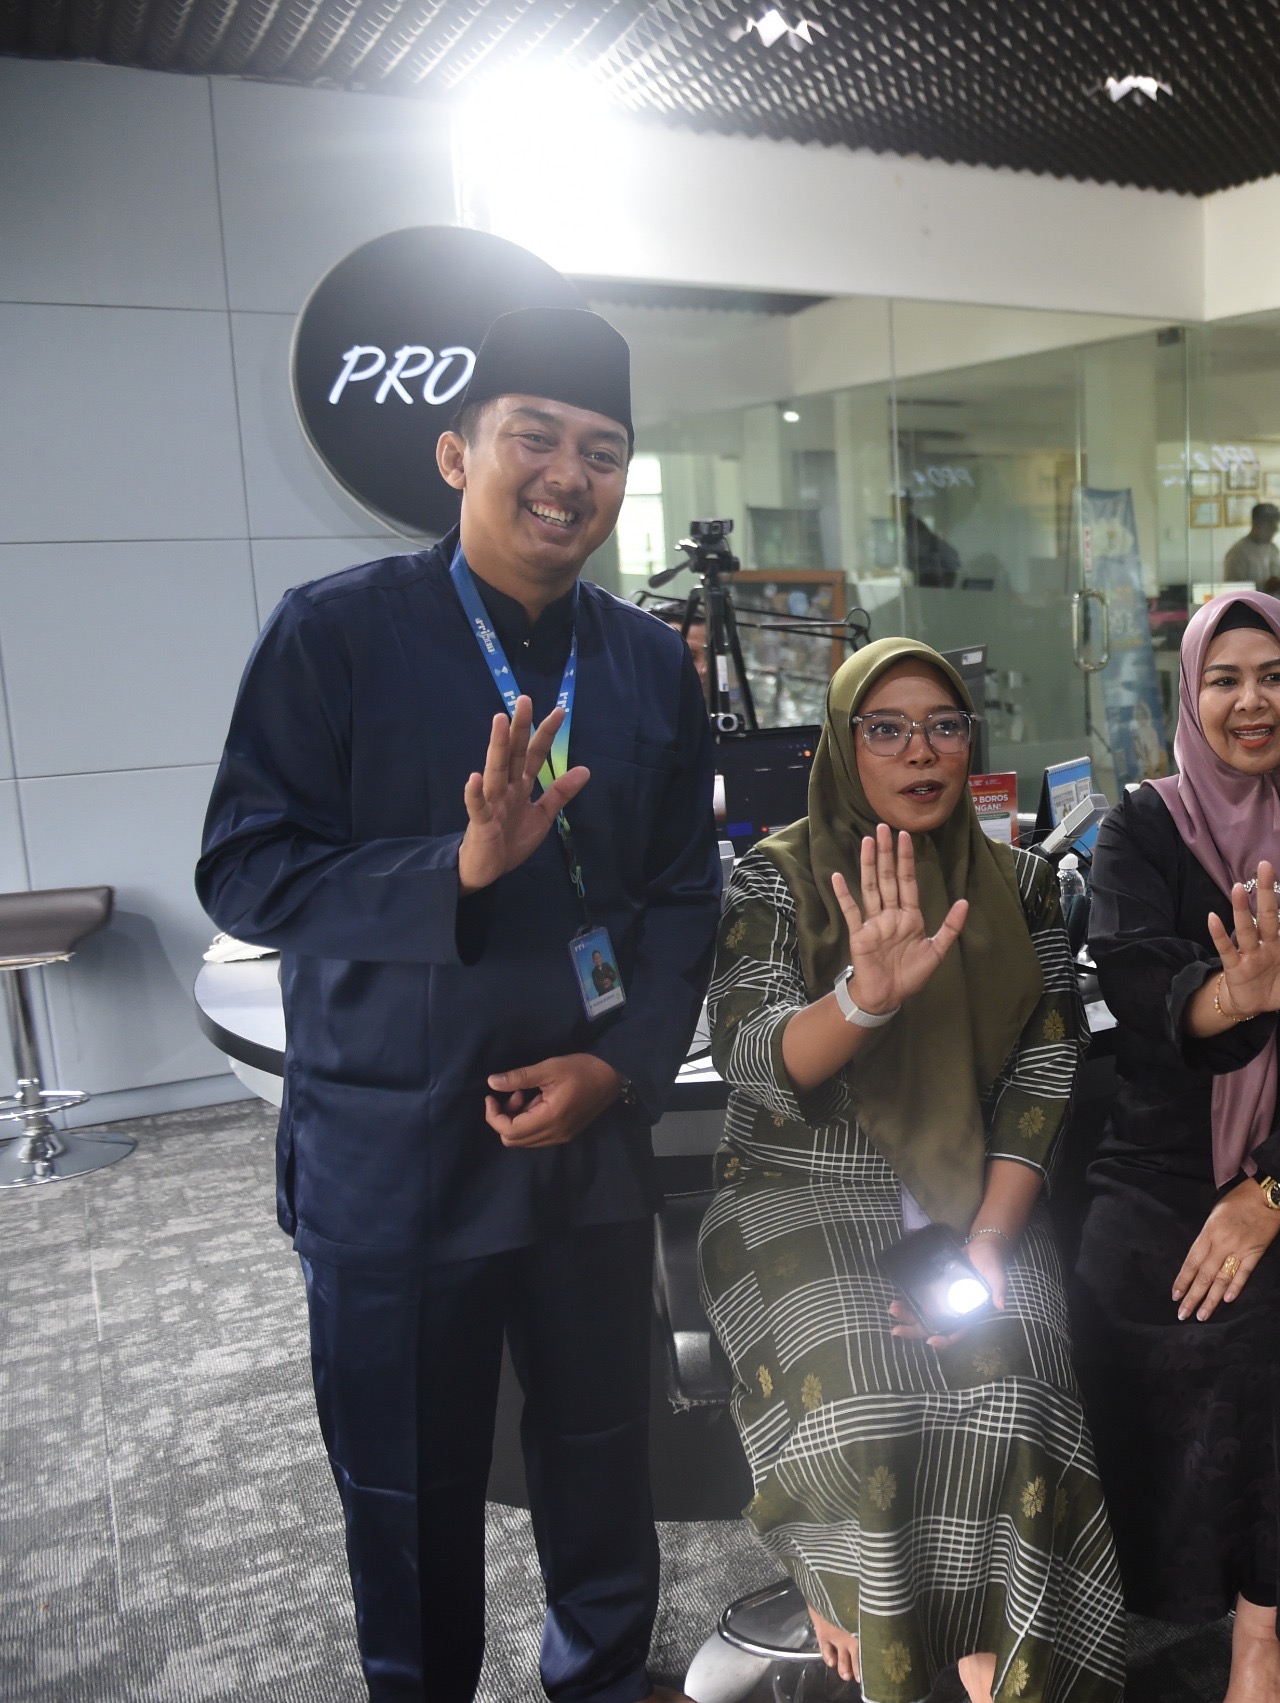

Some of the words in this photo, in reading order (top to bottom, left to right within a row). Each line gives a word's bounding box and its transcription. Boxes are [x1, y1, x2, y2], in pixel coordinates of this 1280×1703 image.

[328, 344, 478, 405] PRO
[979, 795, 1008, 803] BOROS
[975, 804, 1001, 812] NGAN!
